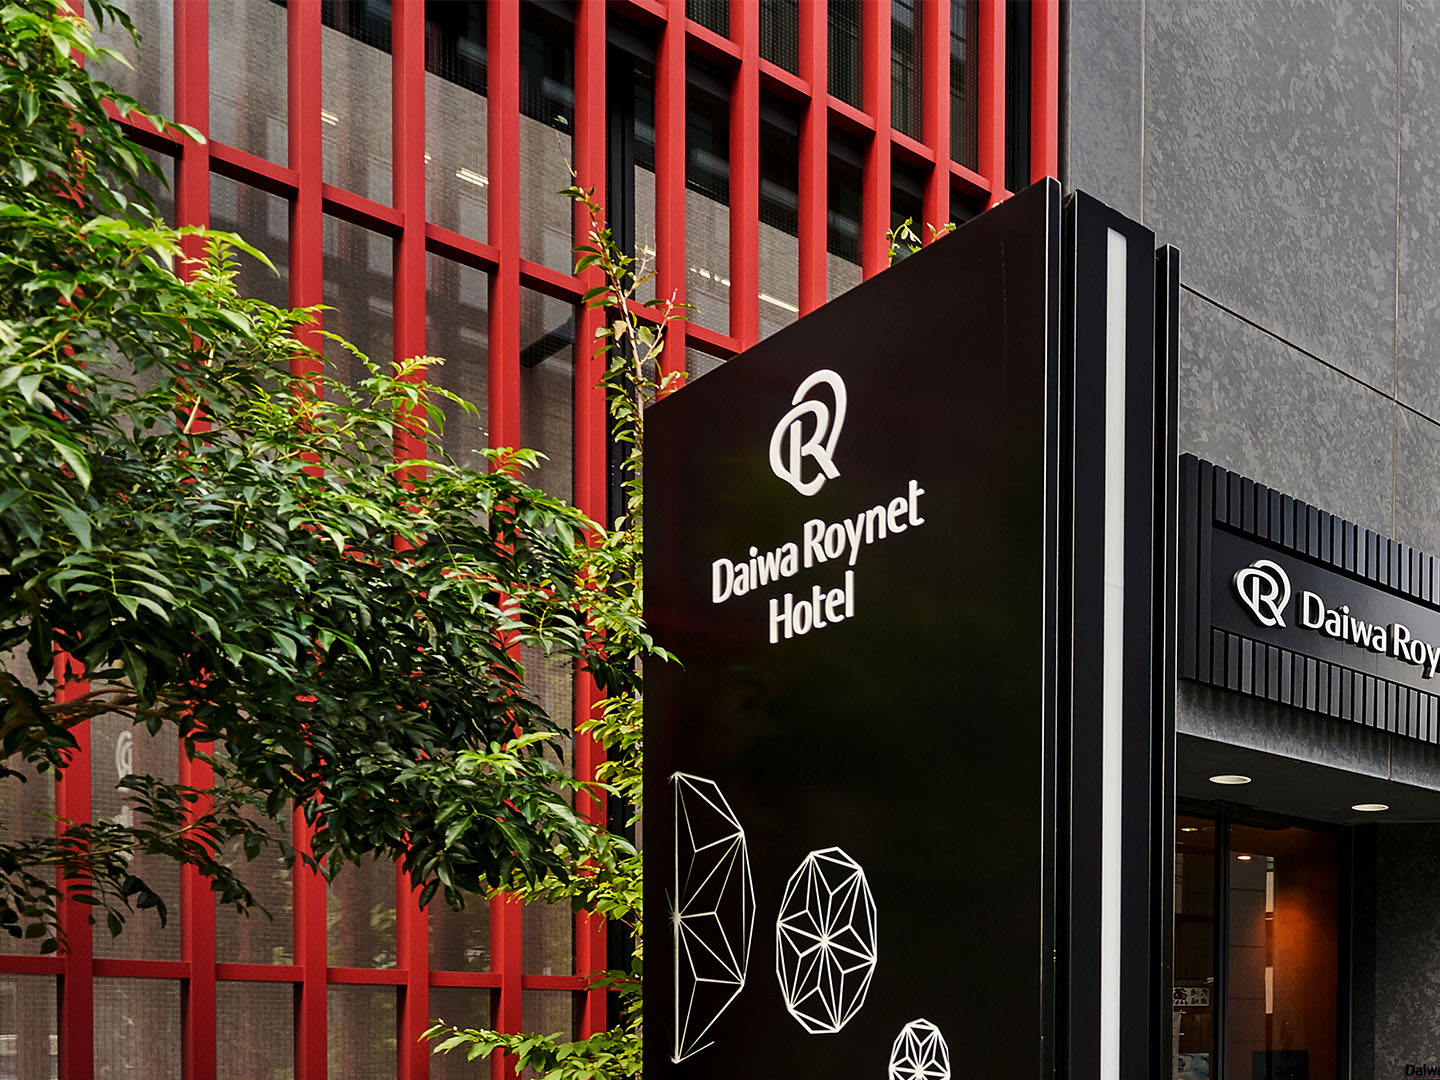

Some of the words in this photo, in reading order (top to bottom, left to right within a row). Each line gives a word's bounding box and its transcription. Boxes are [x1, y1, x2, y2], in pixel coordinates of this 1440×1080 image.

[711, 542, 799, 604] Daiwa
[803, 479, 926, 568] Roynet
[768, 569, 856, 644] Hotel
[1301, 590, 1387, 653] Daiwa
